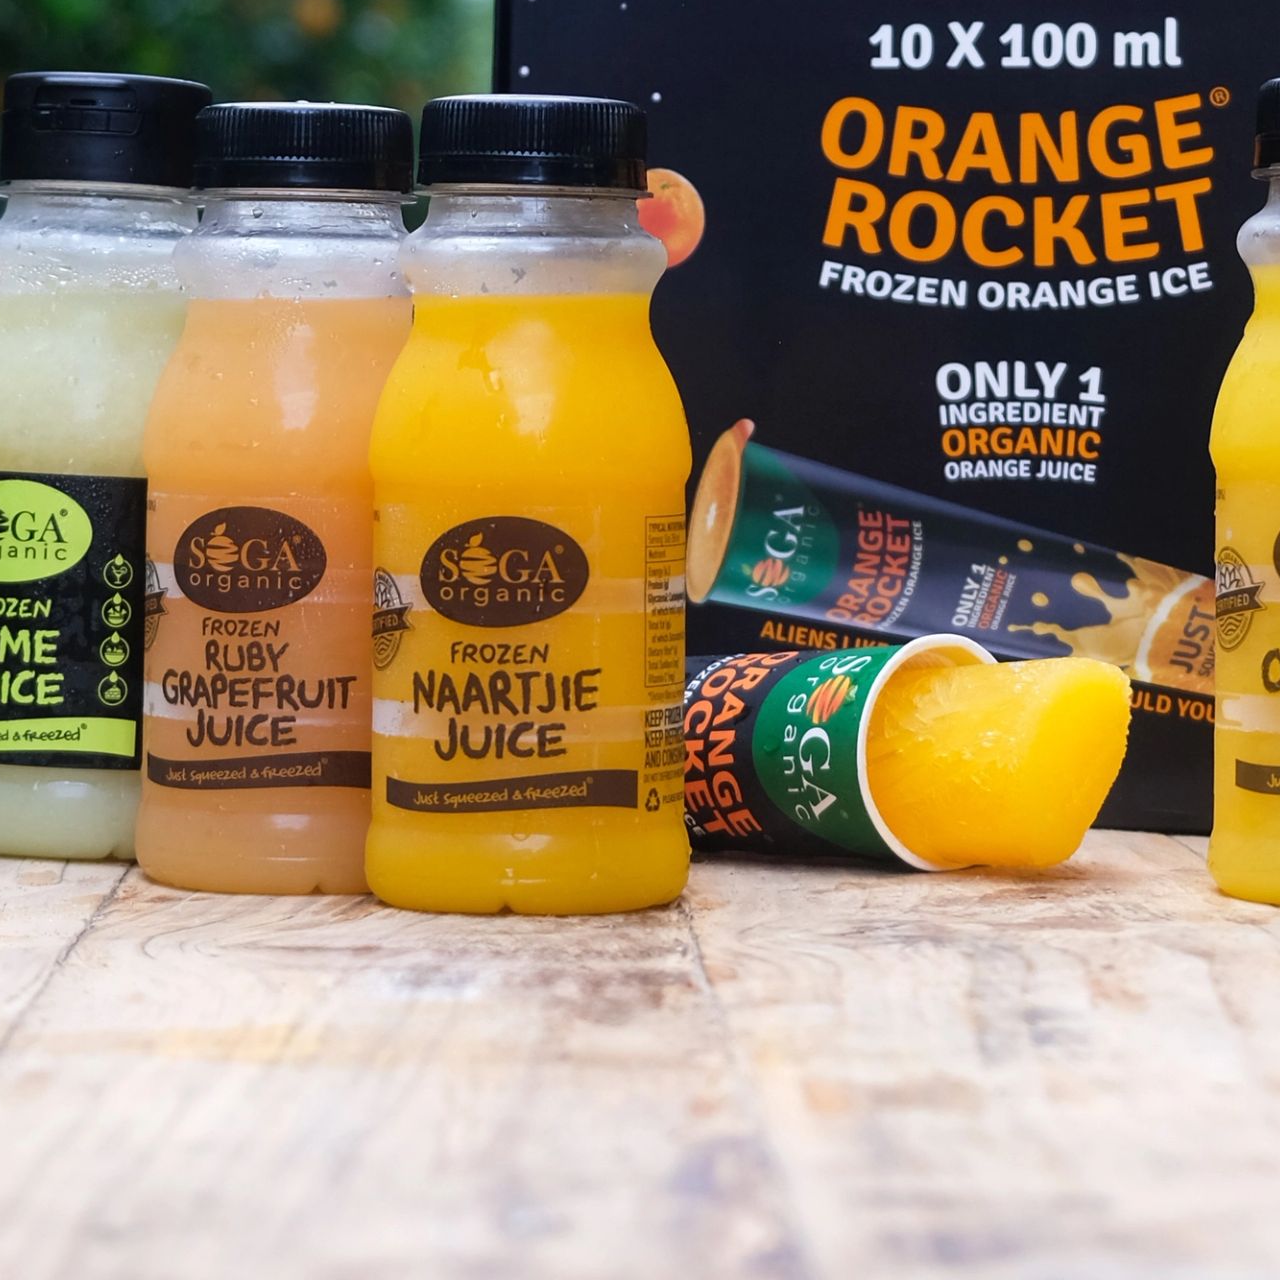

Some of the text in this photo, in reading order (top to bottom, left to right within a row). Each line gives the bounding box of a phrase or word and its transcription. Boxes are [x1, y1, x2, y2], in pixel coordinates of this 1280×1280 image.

[868, 17, 1183, 70] 10 X 100 ml
[819, 92, 1215, 186] ORANGE
[821, 176, 1213, 268] ROCKET
[818, 259, 1213, 308] FROZEN ORANGE ICE
[935, 360, 1107, 404] ONLY 1
[938, 401, 1106, 428] INGREDIENT
[941, 427, 1102, 460] ORGANIC
[944, 458, 1097, 483] ORANGE JUICE
[912, 520, 925, 541] ICE
[777, 503, 821, 605] organic
[825, 510, 884, 622] ORANGE
[852, 513, 912, 626] ROCKET
[904, 540, 924, 597] ORANGE
[189, 569, 303, 593] organic
[440, 582, 565, 607] organic
[951, 563, 986, 627] ONLY 1
[967, 565, 996, 628] INGREDIENT
[978, 568, 1009, 630] ORGANIC
[990, 573, 1017, 631] ORANGE JUICE
[1217, 593, 1251, 613] ERTIFIED
[202, 617, 281, 638] FROZEN
[760, 619, 837, 651] ALIENS
[1169, 604, 1216, 674] JUST
[205, 639, 290, 672] RUBY
[450, 641, 550, 665] FROZEN
[162, 669, 358, 711] GRAPEFRUIT
[412, 668, 602, 716] NAARTJIE
[1130, 690, 1172, 714] ULD
[186, 709, 297, 748] JUICE
[434, 717, 568, 762] JUICE
[645, 709, 663, 729] KEEP
[645, 729, 663, 749] KEEP
[783, 656, 832, 821] organic
[645, 750, 661, 769] AND
[684, 653, 758, 837] ROCKET
[706, 651, 799, 837] ORANGE
[190, 767, 247, 786] squeezed
[413, 788, 441, 806] Just
[443, 788, 508, 810] squeezed
